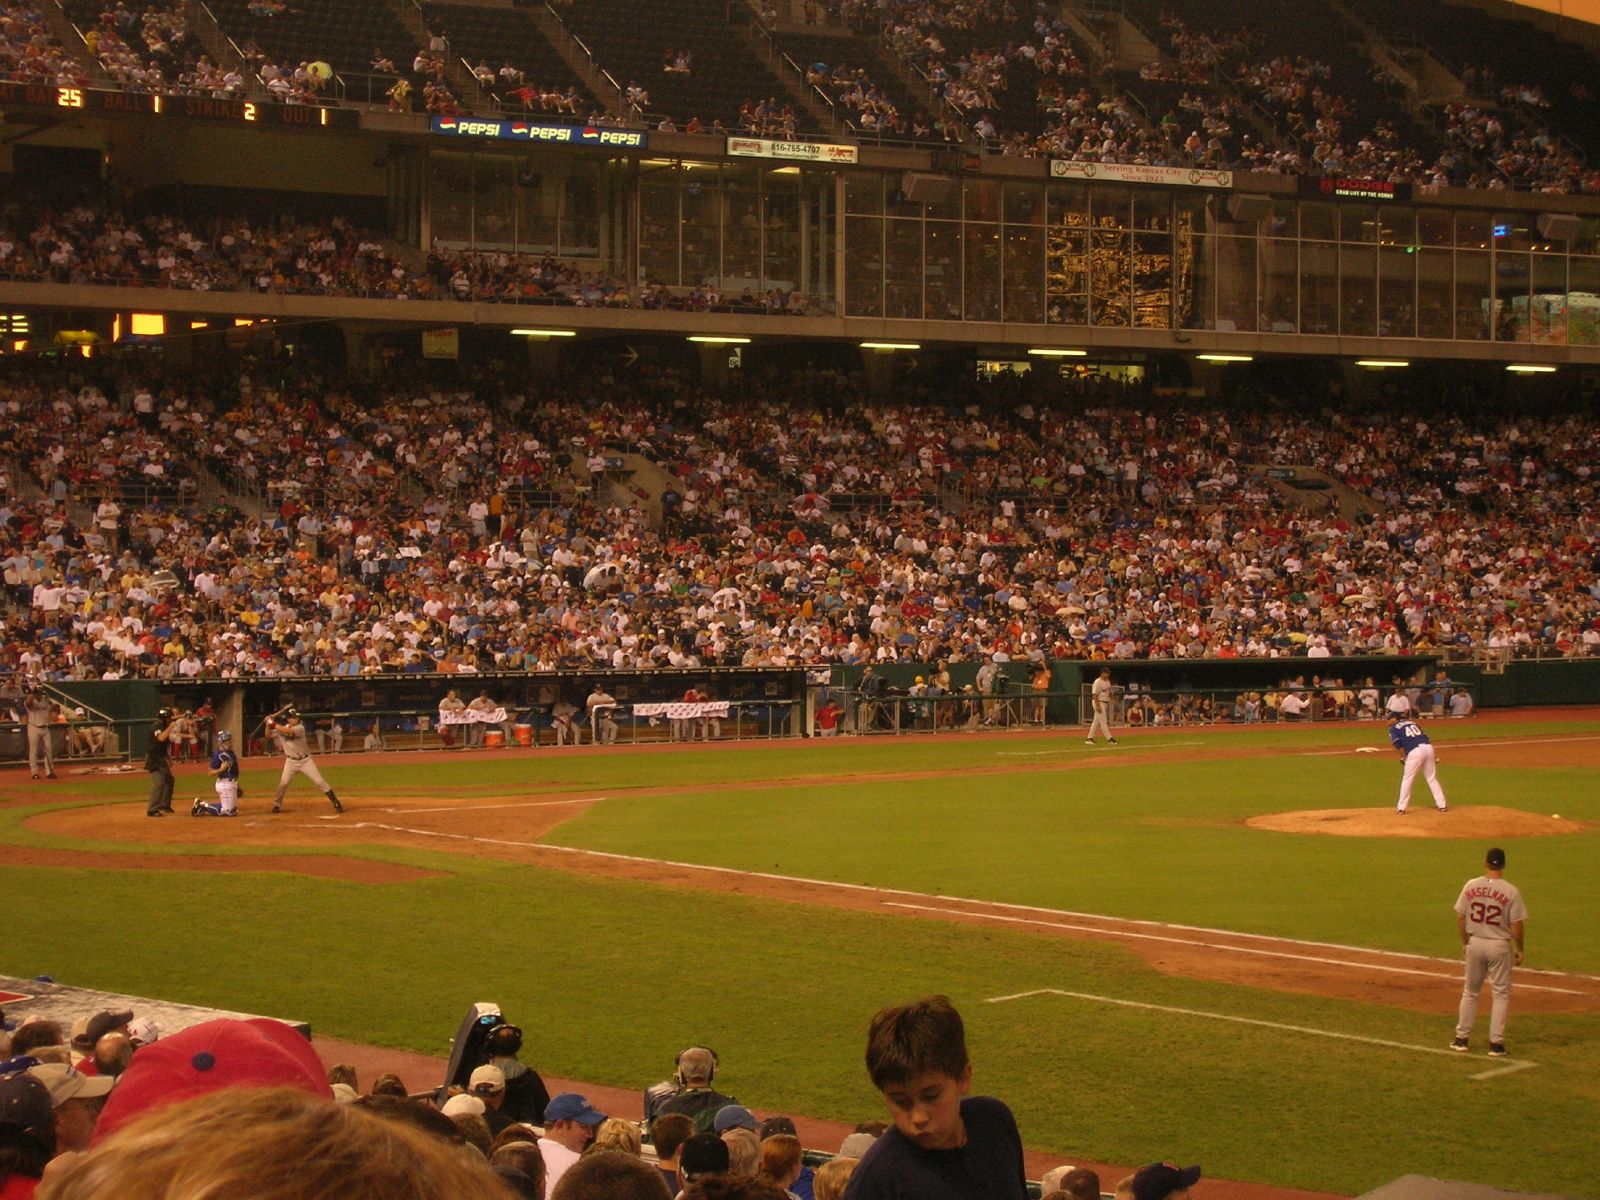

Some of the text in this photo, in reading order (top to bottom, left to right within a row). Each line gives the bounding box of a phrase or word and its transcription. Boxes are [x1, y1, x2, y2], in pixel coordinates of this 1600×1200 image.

[57, 87, 84, 108] 25
[104, 94, 144, 112] BALL
[154, 95, 161, 114] 1
[244, 102, 257, 121] 2
[320, 107, 327, 126] 1
[458, 121, 640, 146] PEPSI PEPSI PEPSI
[771, 142, 820, 154] 816-765-4707
[1103, 165, 1181, 177] Serving Kansas City
[1335, 178, 1393, 192] DODGE
[1405, 724, 1422, 737] 40
[1465, 887, 1510, 906] HASELMAN
[1470, 901, 1502, 927] 32
